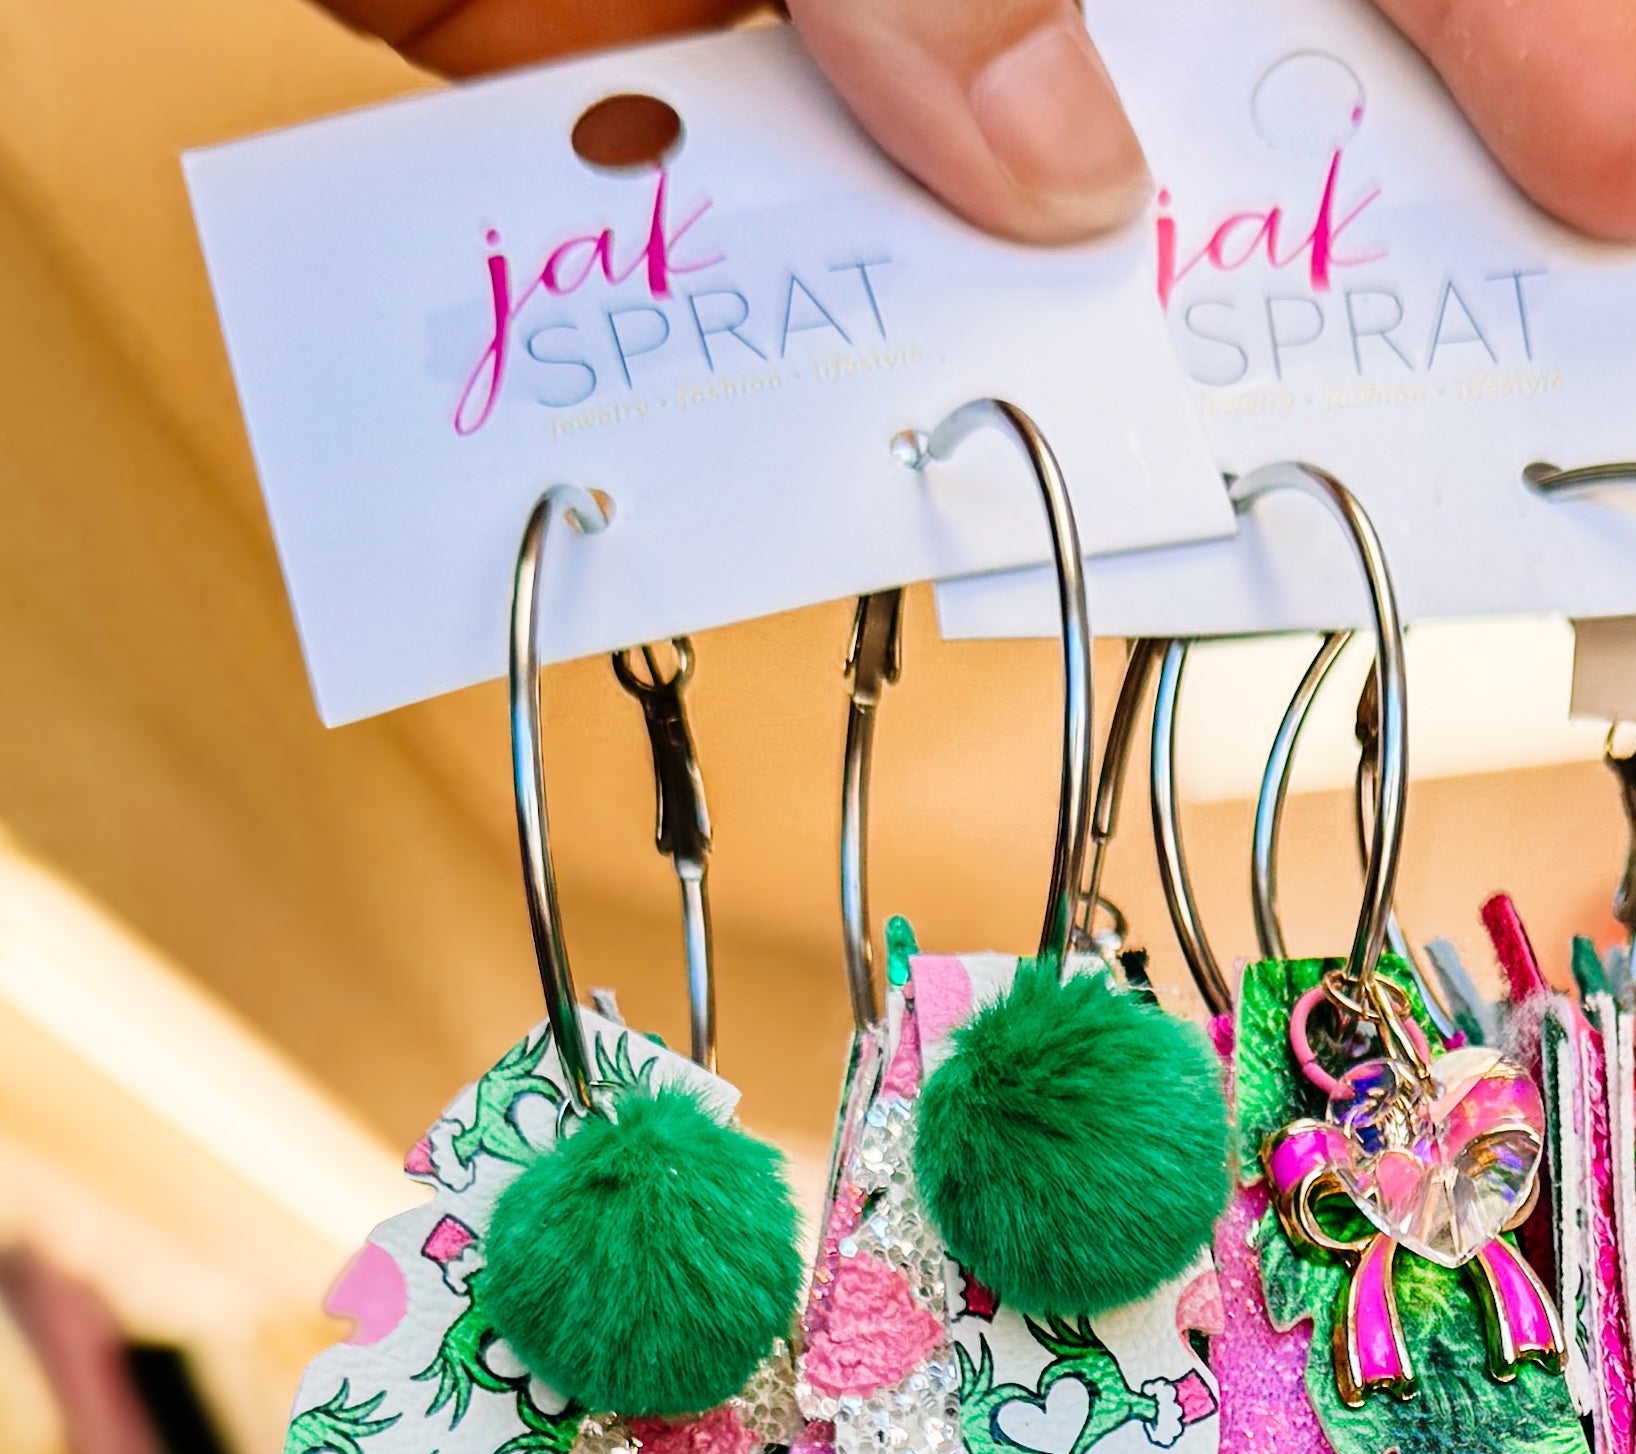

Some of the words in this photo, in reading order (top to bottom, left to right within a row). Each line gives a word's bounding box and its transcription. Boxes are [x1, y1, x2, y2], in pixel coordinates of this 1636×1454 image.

[455, 165, 726, 437] jak
[526, 257, 893, 409] SPRAT
[1184, 268, 1549, 388] SPRAT
[677, 371, 783, 411] fashion
[812, 343, 924, 383] lifestyle
